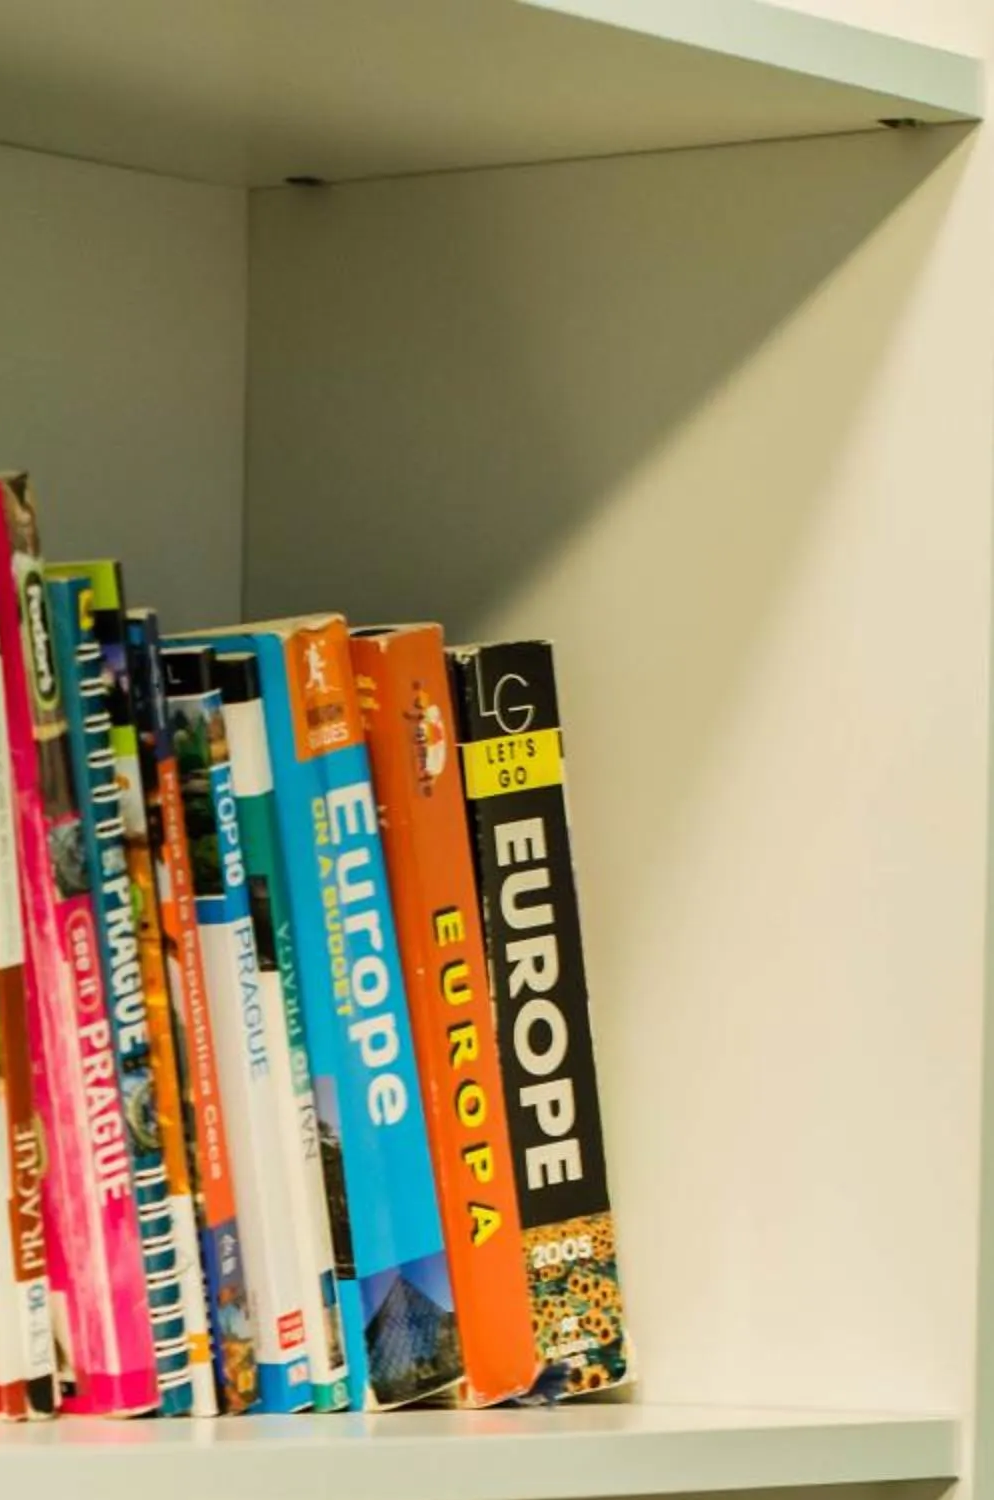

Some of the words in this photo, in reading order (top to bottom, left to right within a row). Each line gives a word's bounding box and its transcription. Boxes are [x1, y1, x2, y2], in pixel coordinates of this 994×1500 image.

[25, 582, 54, 695] Fodor's
[474, 650, 536, 734] LG
[485, 737, 537, 765] LET'S
[498, 765, 528, 789] GO
[164, 770, 182, 860] Praga
[213, 768, 237, 851] TOP
[312, 797, 330, 846] ON
[175, 868, 186, 886] e
[178, 894, 195, 922] la
[224, 851, 247, 887] 10
[317, 854, 335, 879] A
[71, 924, 92, 972] see
[77, 976, 100, 997] it
[102, 873, 148, 1053] PRAGUE
[276, 920, 302, 1039] PRAGA
[321, 885, 357, 1018] BUDGET
[325, 781, 408, 1127] Europe
[182, 928, 215, 1097] Repubblica
[234, 924, 270, 1082] PRAGUE
[493, 816, 584, 1192] EUROPE
[77, 1019, 133, 1206] PRAGUE
[432, 904, 503, 1249] EUROPA
[203, 1103, 223, 1181] Ceca
[13, 1124, 47, 1269] PRAGUE
[531, 1234, 594, 1270] 2005
[26, 1284, 46, 1314] 10
